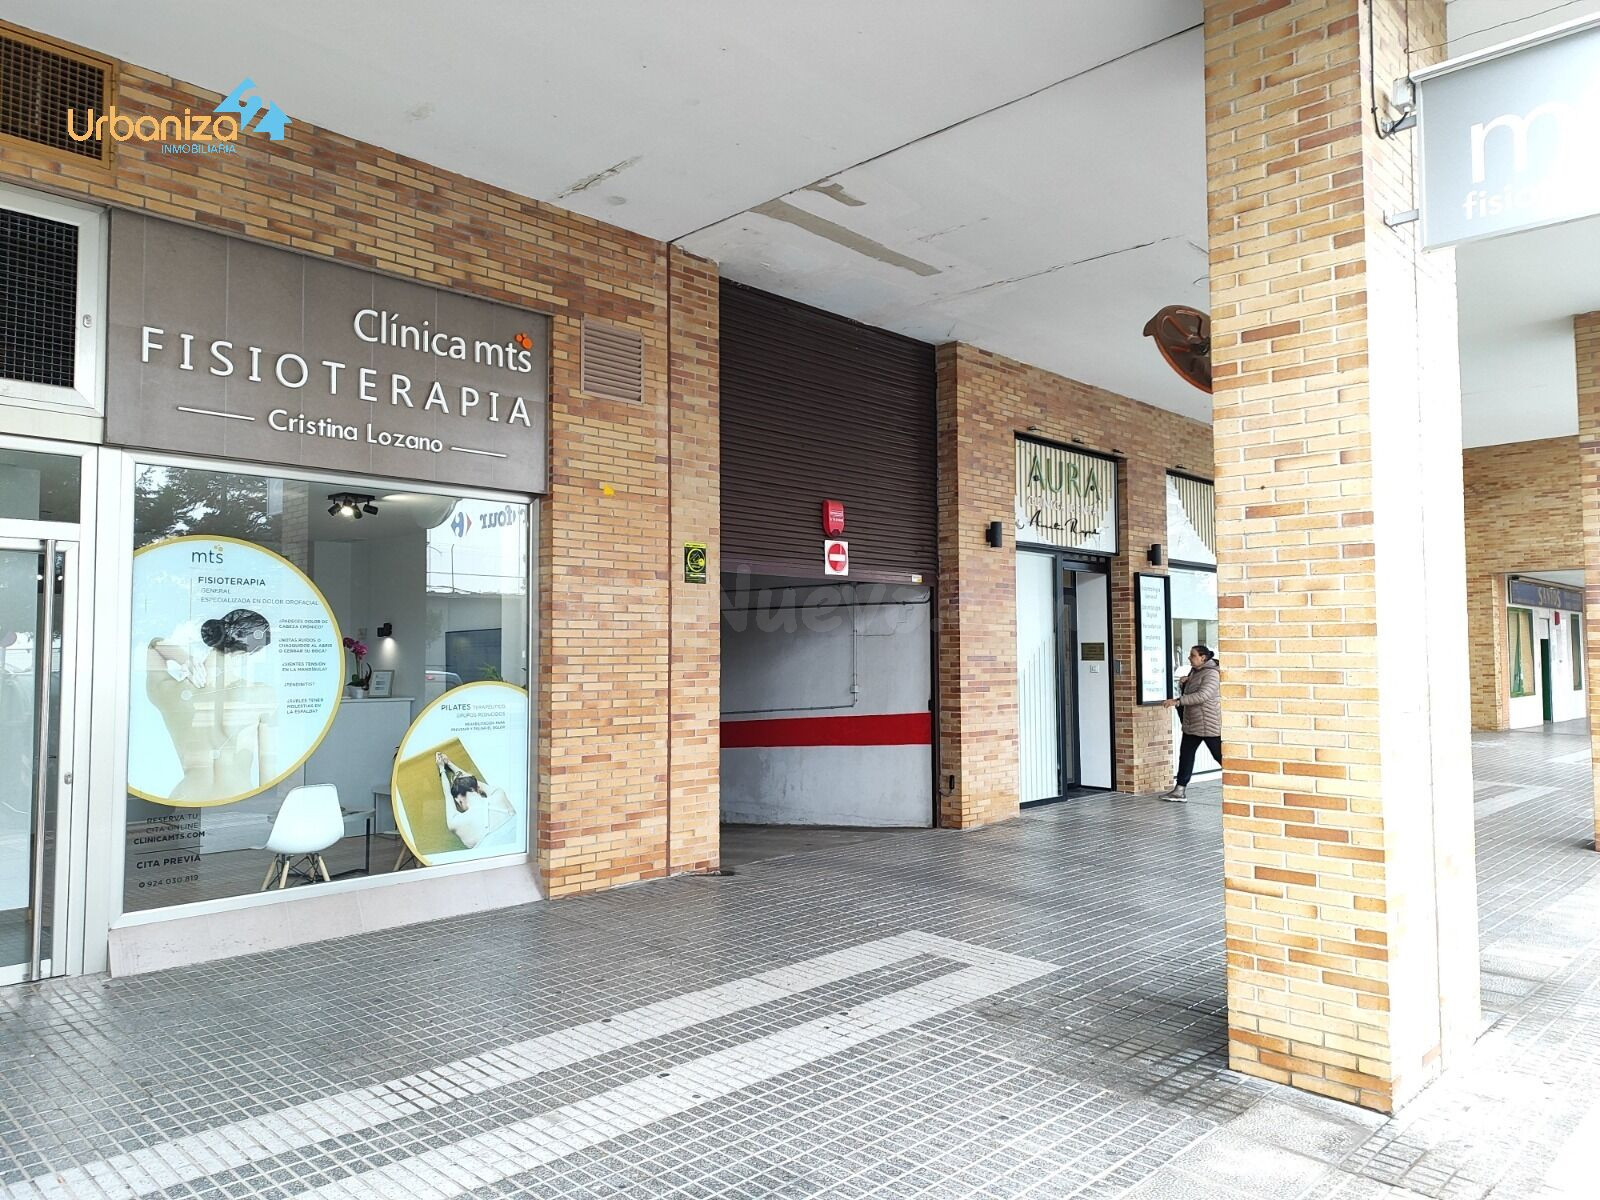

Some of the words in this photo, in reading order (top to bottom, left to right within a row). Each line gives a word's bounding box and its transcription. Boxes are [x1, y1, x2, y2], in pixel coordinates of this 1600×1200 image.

[353, 308, 467, 361] Clínica
[474, 338, 533, 374] mts
[140, 325, 532, 428] FISIOTERAPIA
[267, 408, 358, 442] Cristina
[366, 423, 444, 453] Lozano
[1027, 455, 1101, 501] AURA
[191, 549, 224, 565] mts
[198, 576, 266, 587] FISIOTERAPIA
[200, 596, 251, 605] ESPECIALIZADA
[441, 703, 471, 711] PILATES
[146, 814, 185, 824] RESERVA
[145, 826, 165, 834] CITA
[167, 822, 199, 831] ONLINE
[133, 831, 205, 845] CLINICAMTS.COM
[136, 860, 160, 869] CITA
[163, 855, 201, 866] PREVIA
[146, 879, 163, 888] 924
[165, 877, 183, 885] 030
[184, 874, 199, 882] 819
